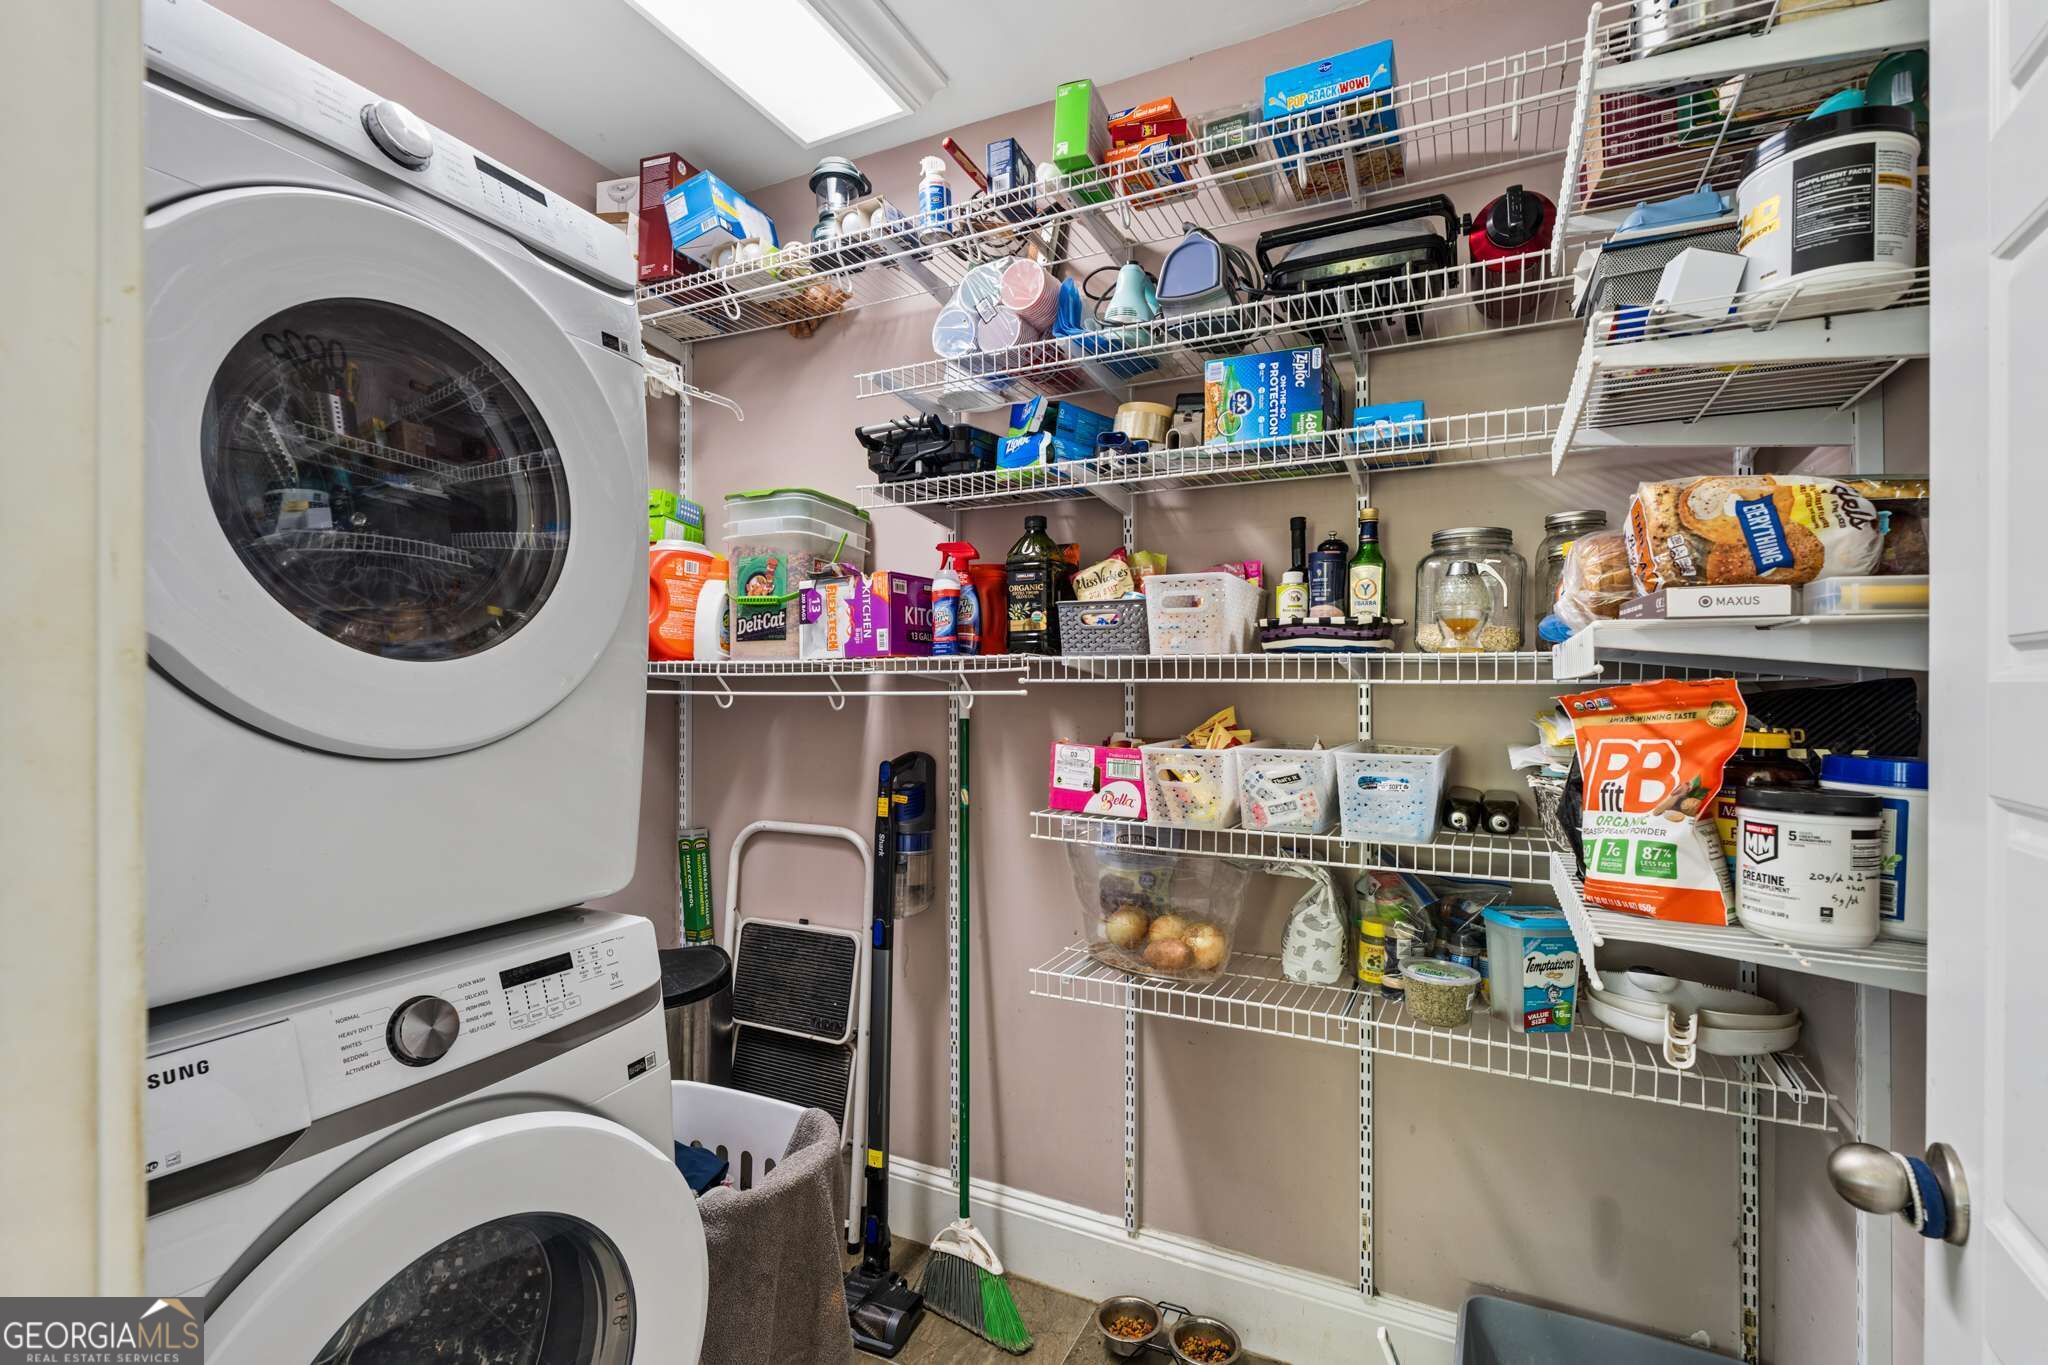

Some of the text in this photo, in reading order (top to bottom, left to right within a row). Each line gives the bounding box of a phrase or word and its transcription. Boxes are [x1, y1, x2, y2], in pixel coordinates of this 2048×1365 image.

[1287, 76, 1370, 109] POP CRACK WOW!
[1848, 167, 1873, 176] FACTS
[1293, 351, 1309, 388] Ziploc
[1236, 393, 1248, 413] 3X
[1269, 362, 1280, 436] PROTECTION
[1005, 436, 1031, 455] Ziploc
[1743, 503, 1784, 565] EERYTHING
[1095, 566, 1128, 585] Vickie's
[1008, 583, 1044, 592] ORGANIC
[1361, 583, 1370, 595] Y
[811, 597, 821, 613] 13
[1715, 596, 1761, 606] MAXUS
[862, 585, 872, 639] KITCHEN
[911, 632, 918, 641] 13
[1674, 711, 1697, 720] TASTE
[1586, 739, 1682, 812] PB
[1101, 790, 1136, 812] Bella
[1601, 781, 1625, 812] fit
[1630, 827, 1667, 837] POWDER
[1788, 830, 1797, 841] 5
[1605, 842, 1621, 857] 7G
[1642, 846, 1672, 860] 87%
[1640, 860, 1657, 868] LESS
[1742, 869, 1785, 887] CREATINE
[1757, 883, 1790, 895] SUPPLEMENT
[1526, 956, 1575, 977] Temptations
[457, 976, 486, 990] QUICK WASH
[464, 989, 489, 1001] DELICATES
[335, 1013, 360, 1025] NORMAL
[1527, 1011, 1550, 1021] VALUE
[1531, 1017, 1547, 1026] SIZE
[338, 1024, 374, 1040] HEAVY DUTY
[468, 1026, 480, 1035] SELF
[341, 1040, 363, 1052] WHITES
[342, 1051, 369, 1064] BEDDING
[146, 1059, 210, 1090] SUNG
[345, 1060, 381, 1077] ACTIVEWEAR
